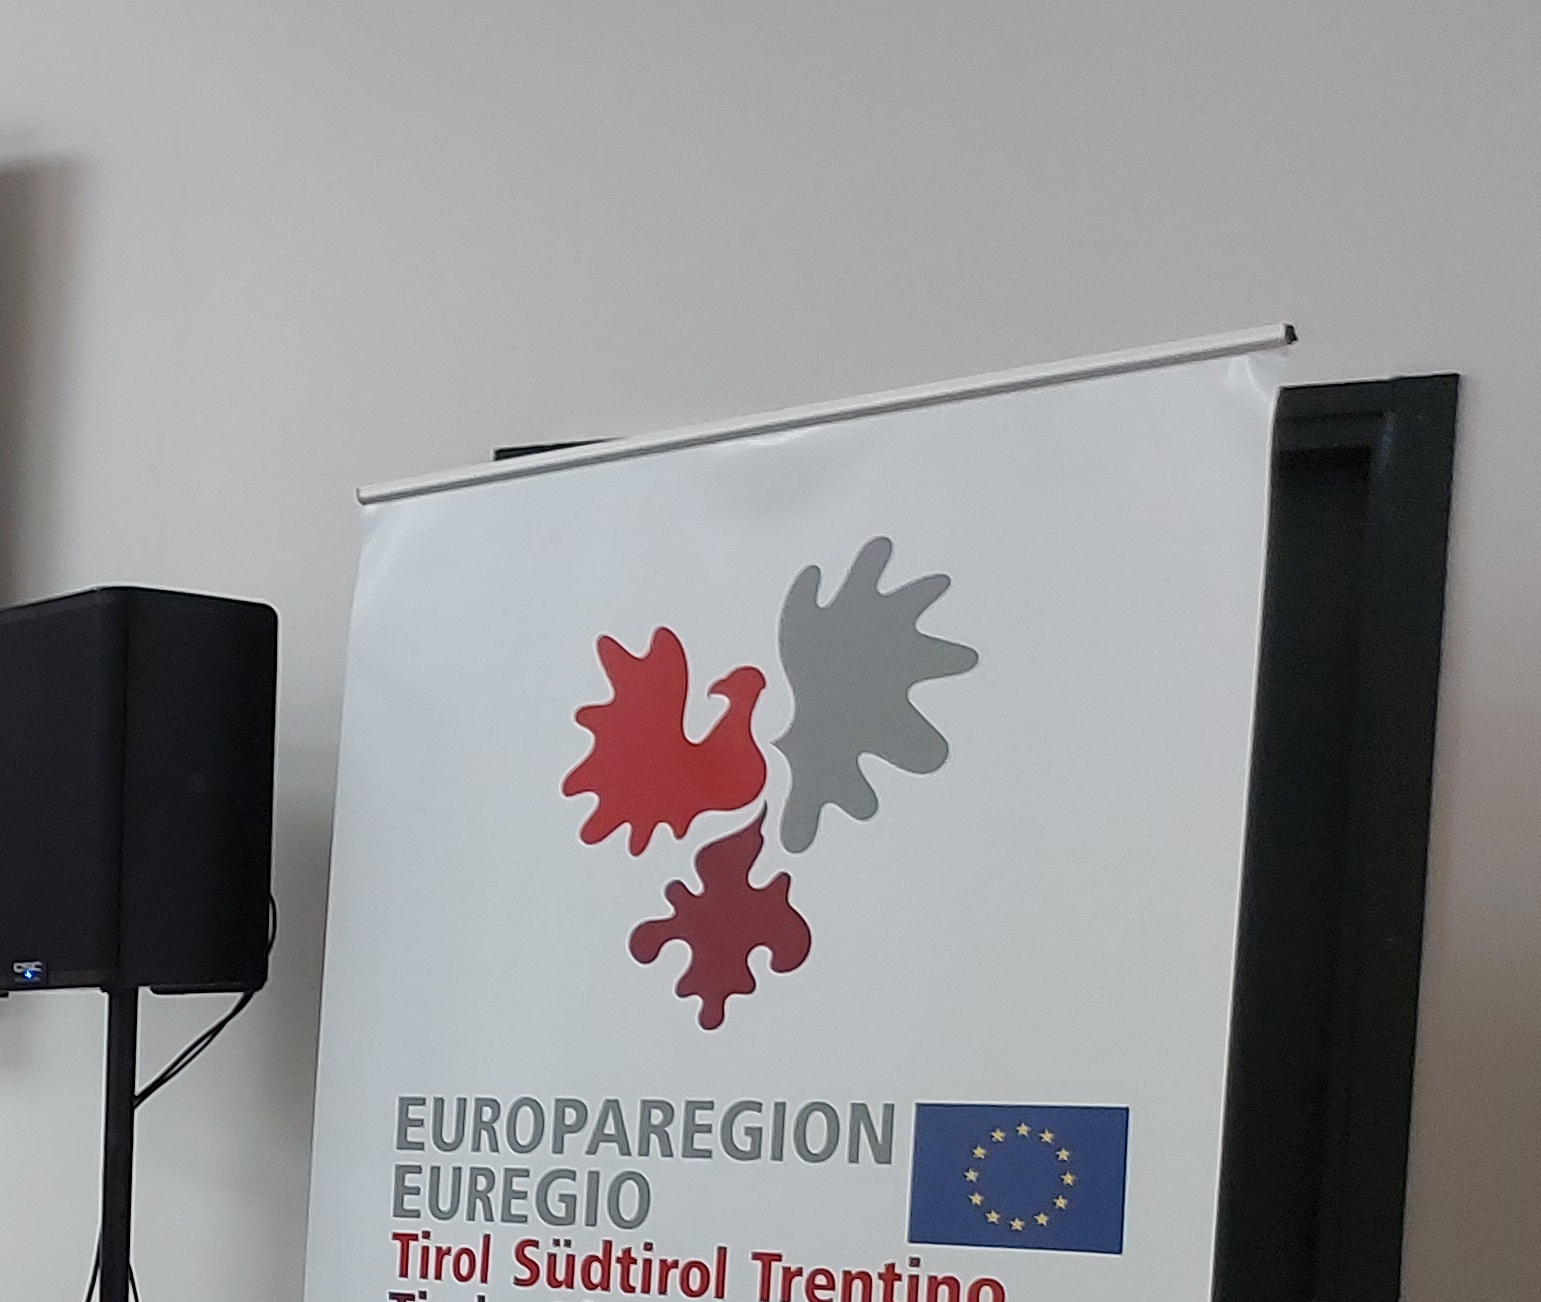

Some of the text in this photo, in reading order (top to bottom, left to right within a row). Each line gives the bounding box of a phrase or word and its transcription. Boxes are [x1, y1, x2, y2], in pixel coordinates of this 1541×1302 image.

[394, 1095, 896, 1166] EUROPAREGION
[391, 1163, 652, 1230] EUREGIO
[391, 1231, 490, 1286] Tirol
[513, 1237, 728, 1300] Südtirol
